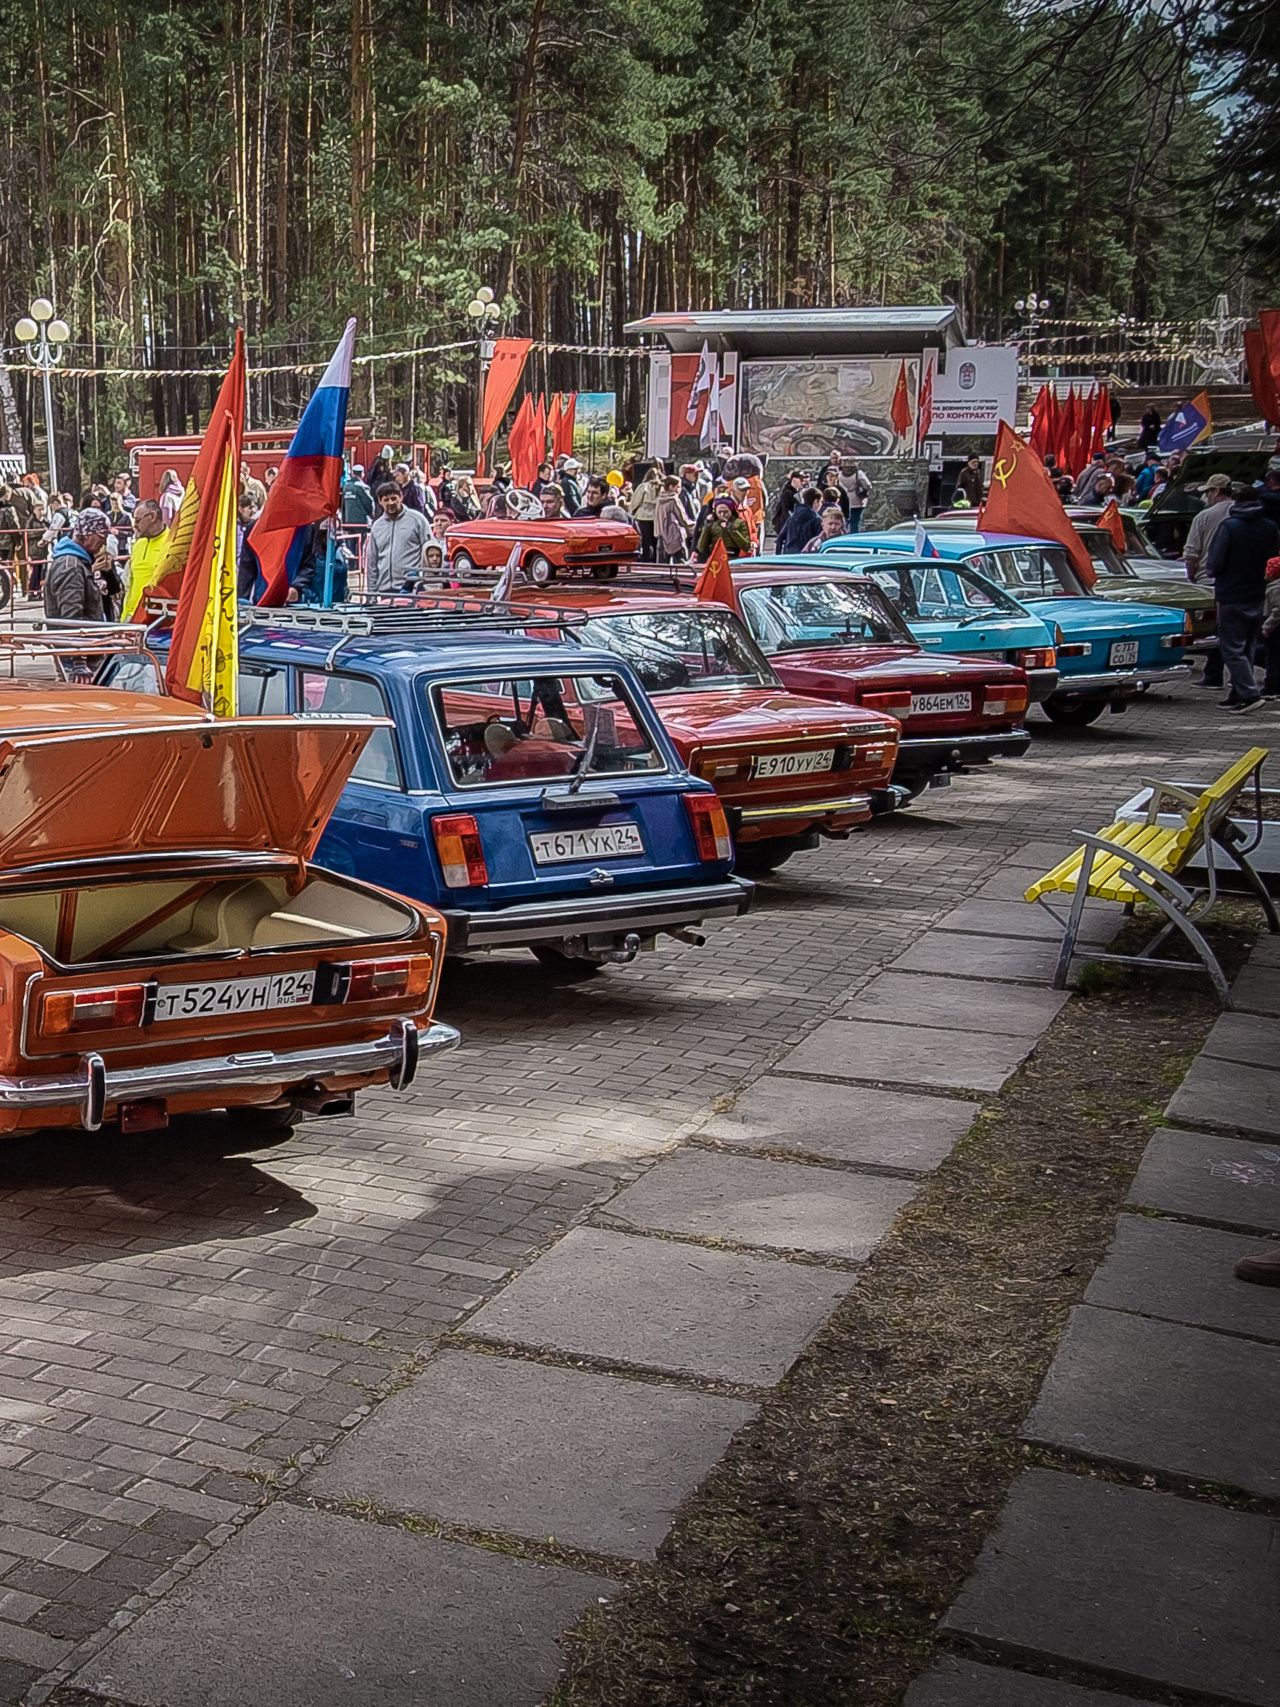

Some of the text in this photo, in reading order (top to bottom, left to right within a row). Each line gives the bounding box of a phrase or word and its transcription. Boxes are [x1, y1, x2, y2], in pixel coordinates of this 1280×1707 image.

[912, 693, 970, 711] У864ЕМ 124
[757, 751, 830, 776] Е910УУ 24
[540, 828, 635, 858] Т671УК 24
[166, 973, 310, 1016] Т524УН 124
[277, 995, 297, 1005] RUS
